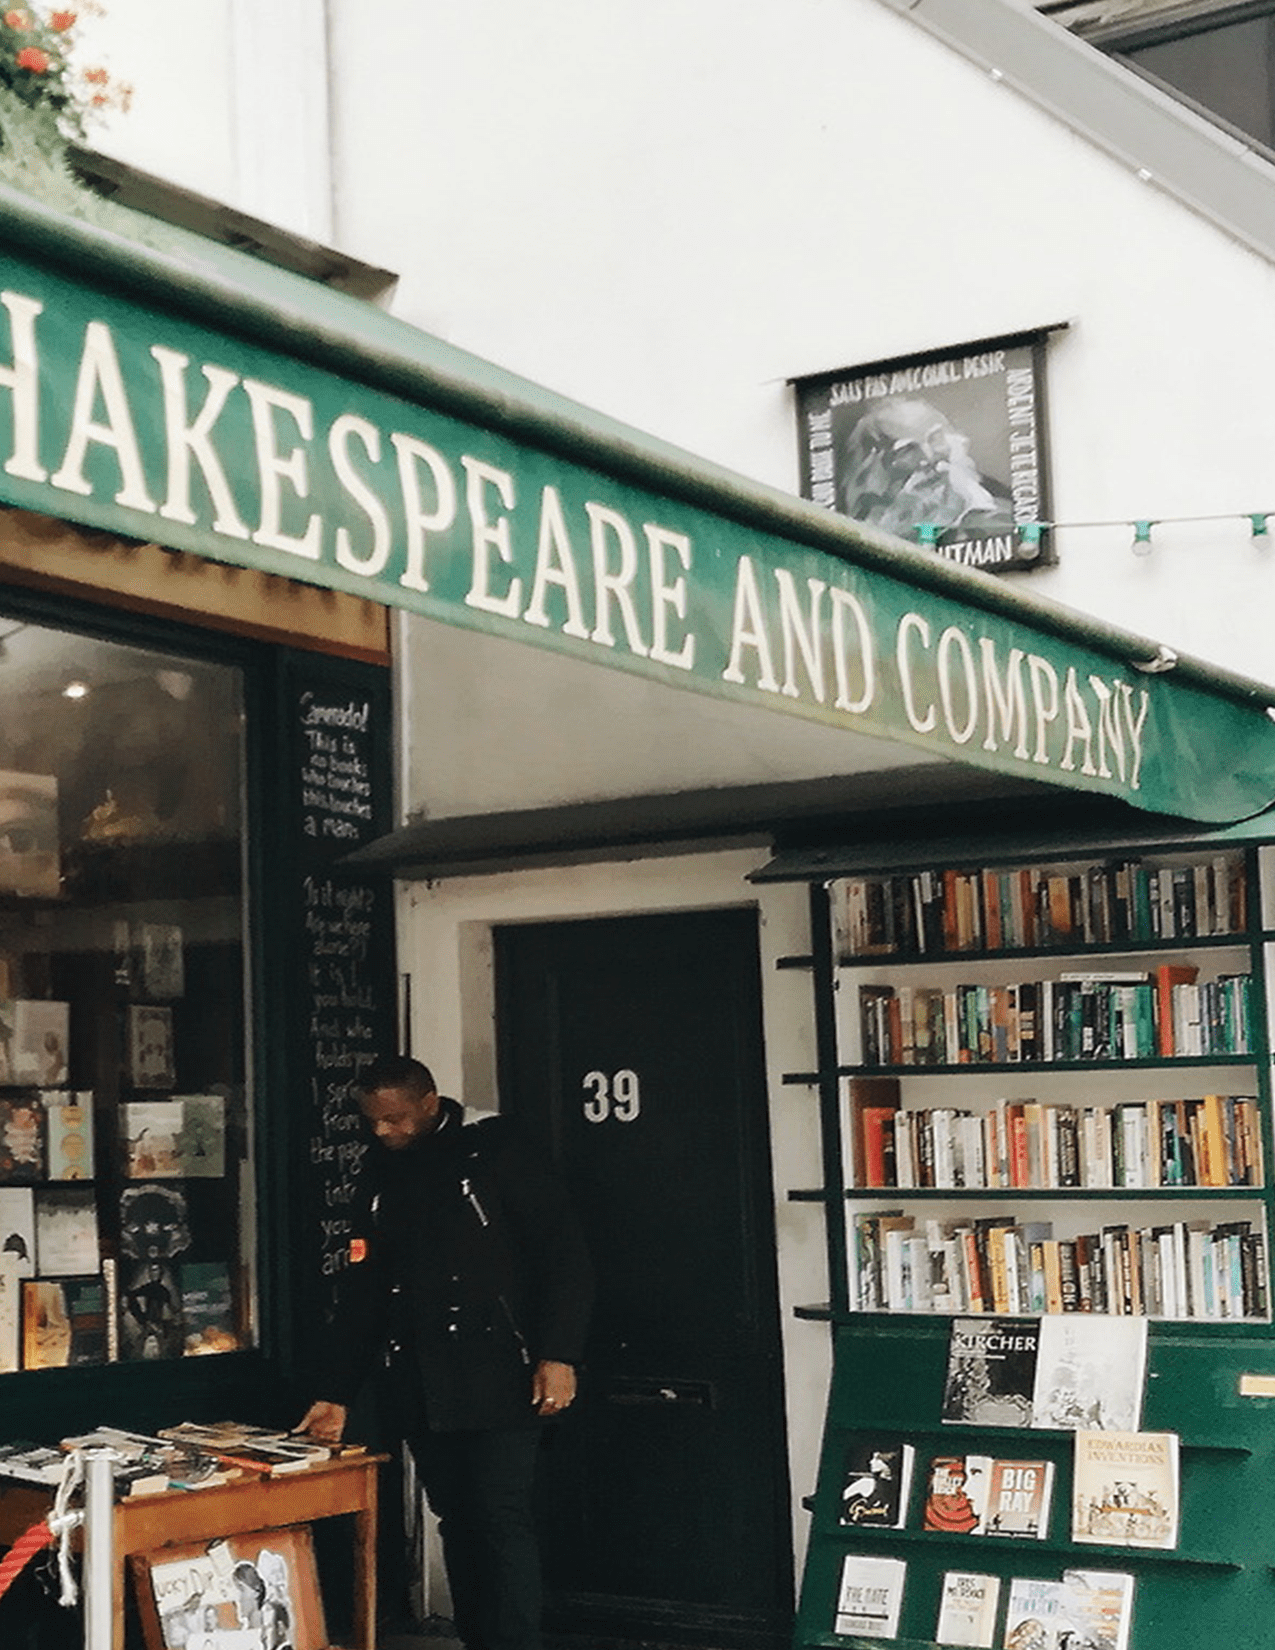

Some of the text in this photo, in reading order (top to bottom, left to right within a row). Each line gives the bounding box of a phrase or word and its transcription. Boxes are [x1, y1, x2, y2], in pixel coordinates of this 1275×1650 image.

[723, 554, 875, 714] AND
[896, 611, 1150, 791] COMPANY
[582, 1069, 642, 1124] 39
[954, 1334, 1037, 1352] KIRCHER
[1087, 1438, 1165, 1454] EDWARDIAN
[1087, 1451, 1165, 1465] INVENTIONS
[1001, 1468, 1037, 1492] BIG
[999, 1491, 1034, 1514] RAY
